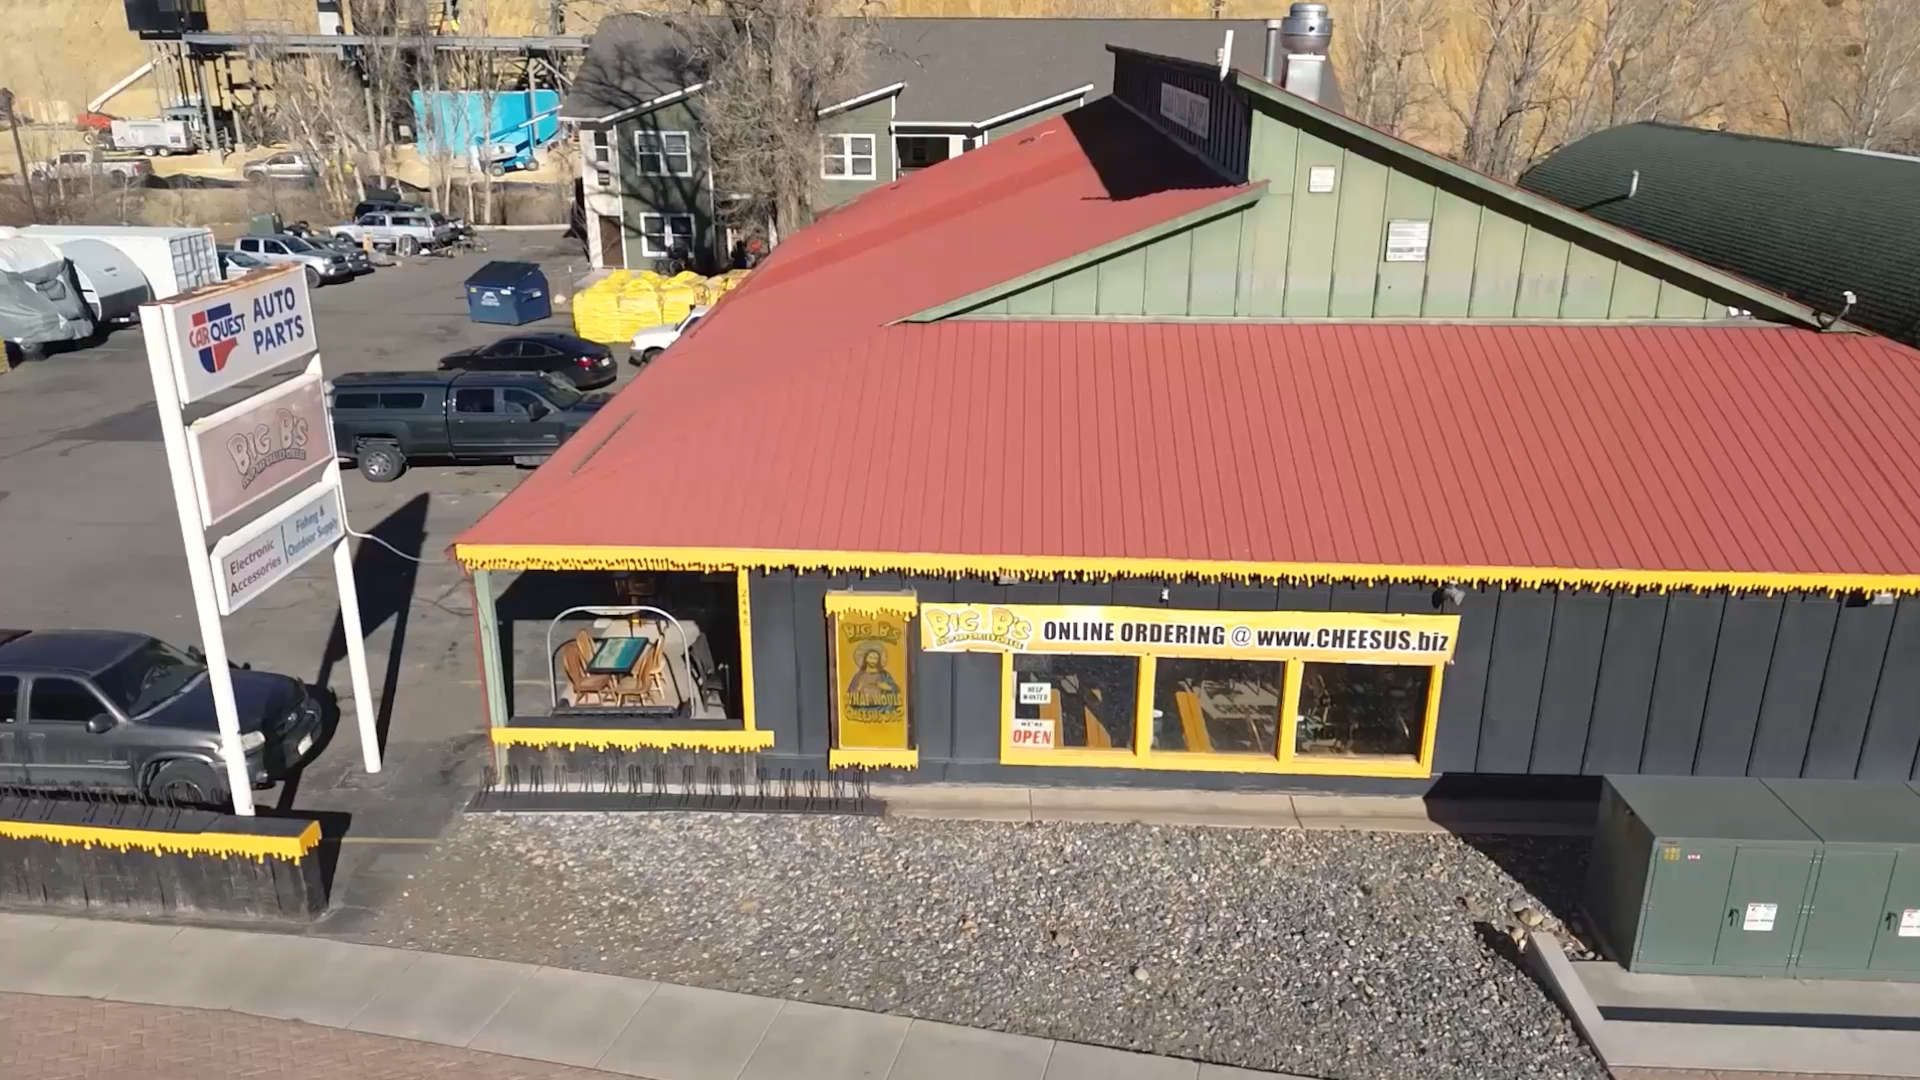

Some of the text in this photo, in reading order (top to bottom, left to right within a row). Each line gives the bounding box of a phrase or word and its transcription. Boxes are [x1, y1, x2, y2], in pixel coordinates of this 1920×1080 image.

[253, 287, 296, 323] AUTO
[189, 313, 246, 349] CARQUEST
[253, 314, 305, 356] PARTS
[227, 423, 271, 476] BIG
[288, 518, 338, 556] Outdoor Supply
[296, 511, 319, 533] Fishing
[230, 538, 276, 576] Electronic
[231, 555, 282, 597] Accessories
[841, 622, 872, 641] BIG
[926, 609, 980, 638] BIG
[1043, 621, 1114, 641] ONLINE
[1120, 623, 1225, 646] ORDERING
[1230, 626, 1252, 647] @
[1257, 628, 1449, 652] www.CHEESUS.biz
[1023, 693, 1048, 701] WANTED
[1012, 729, 1052, 745] OPEN
